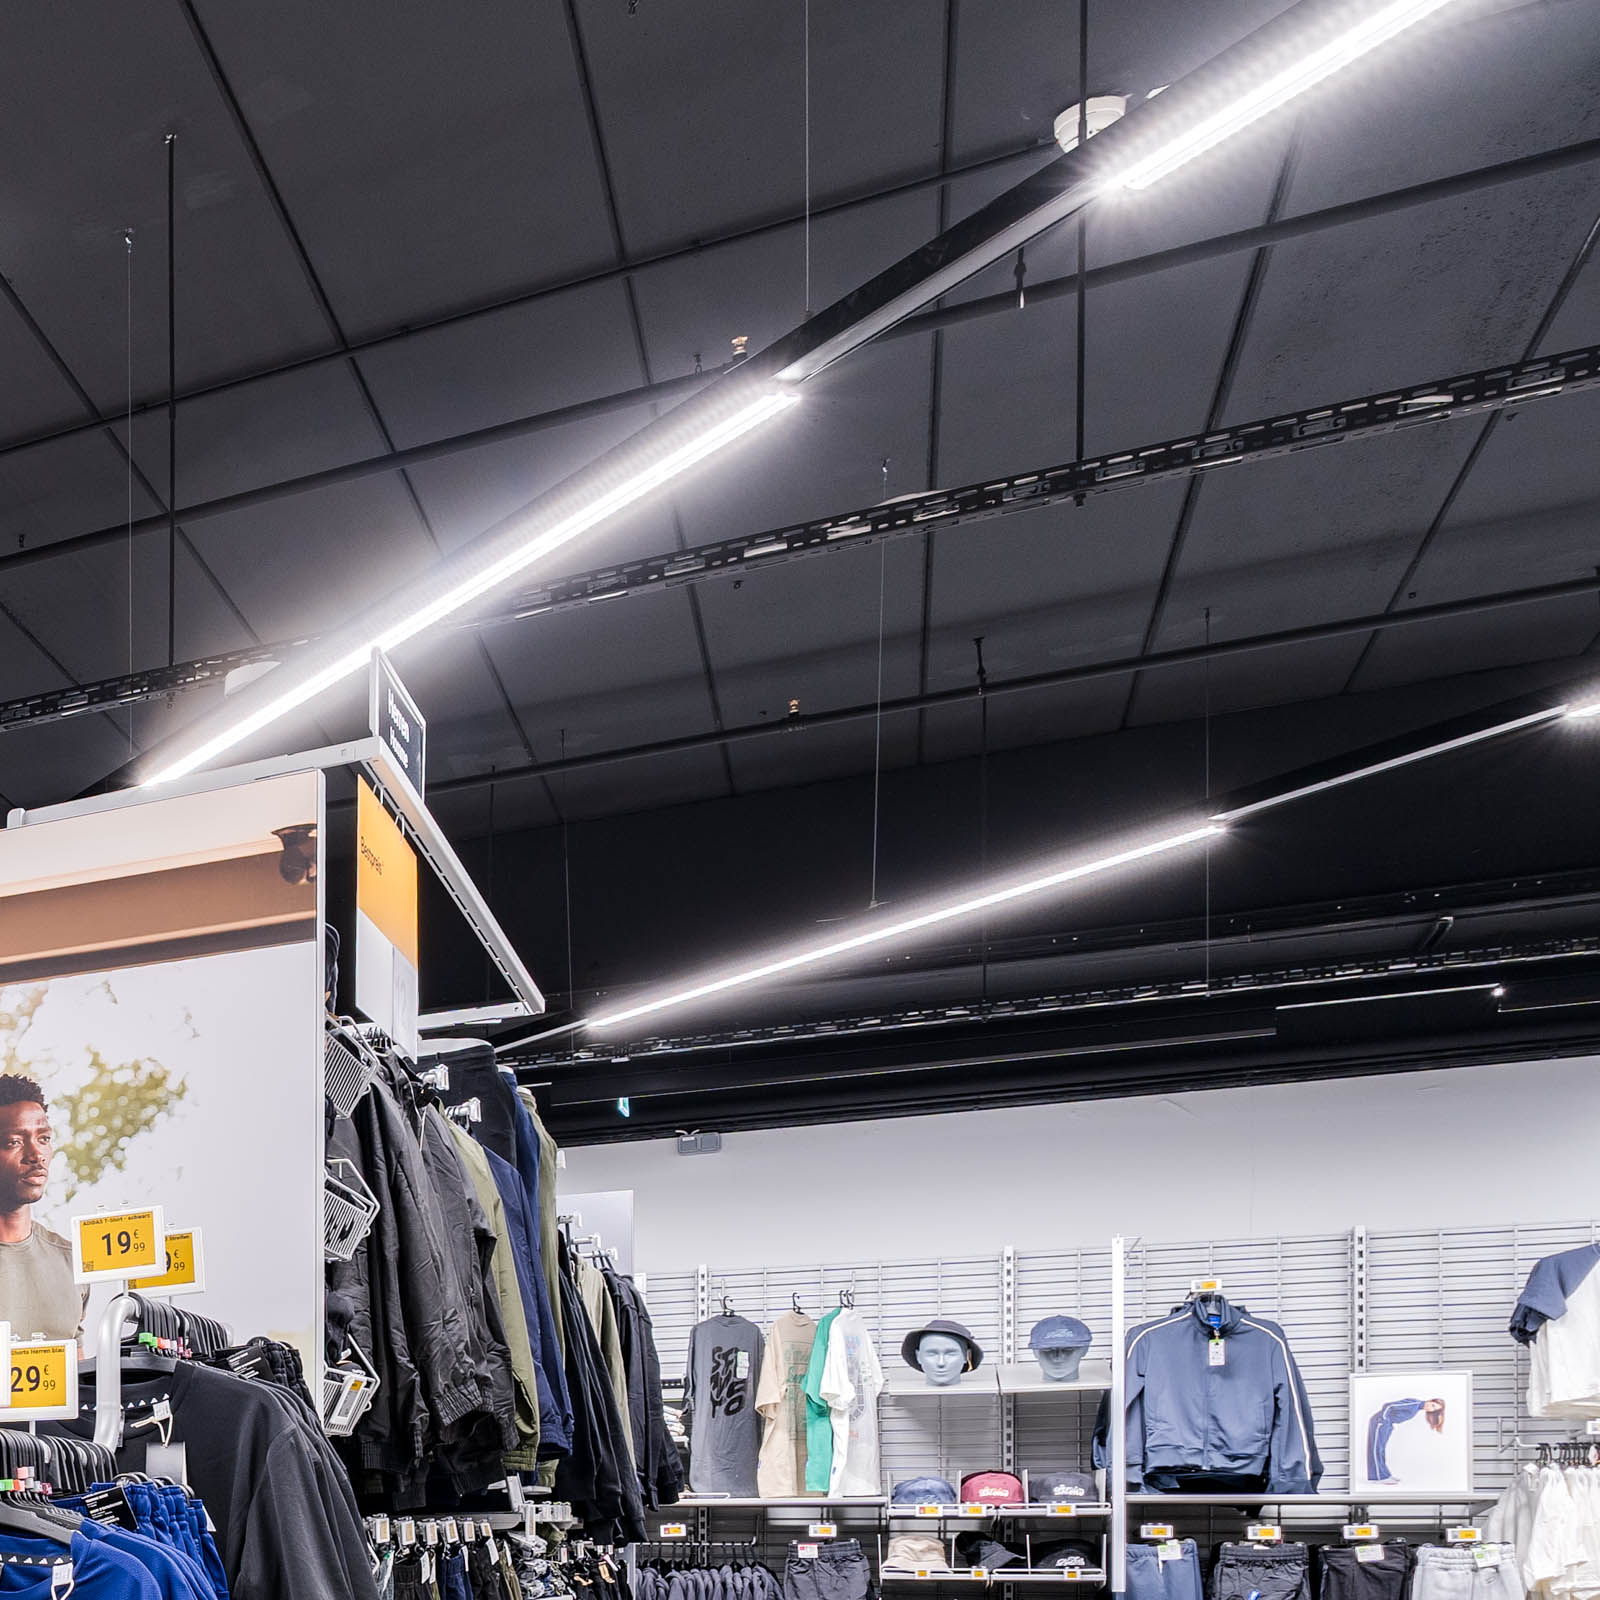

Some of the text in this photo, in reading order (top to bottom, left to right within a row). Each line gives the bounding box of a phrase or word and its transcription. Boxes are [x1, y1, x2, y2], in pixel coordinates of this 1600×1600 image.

[388, 688, 410, 743] Herren
[101, 1231, 131, 1256] 19
[133, 1242, 145, 1252] 99
[11, 1365, 41, 1393] 29
[42, 1379, 56, 1391] 99
